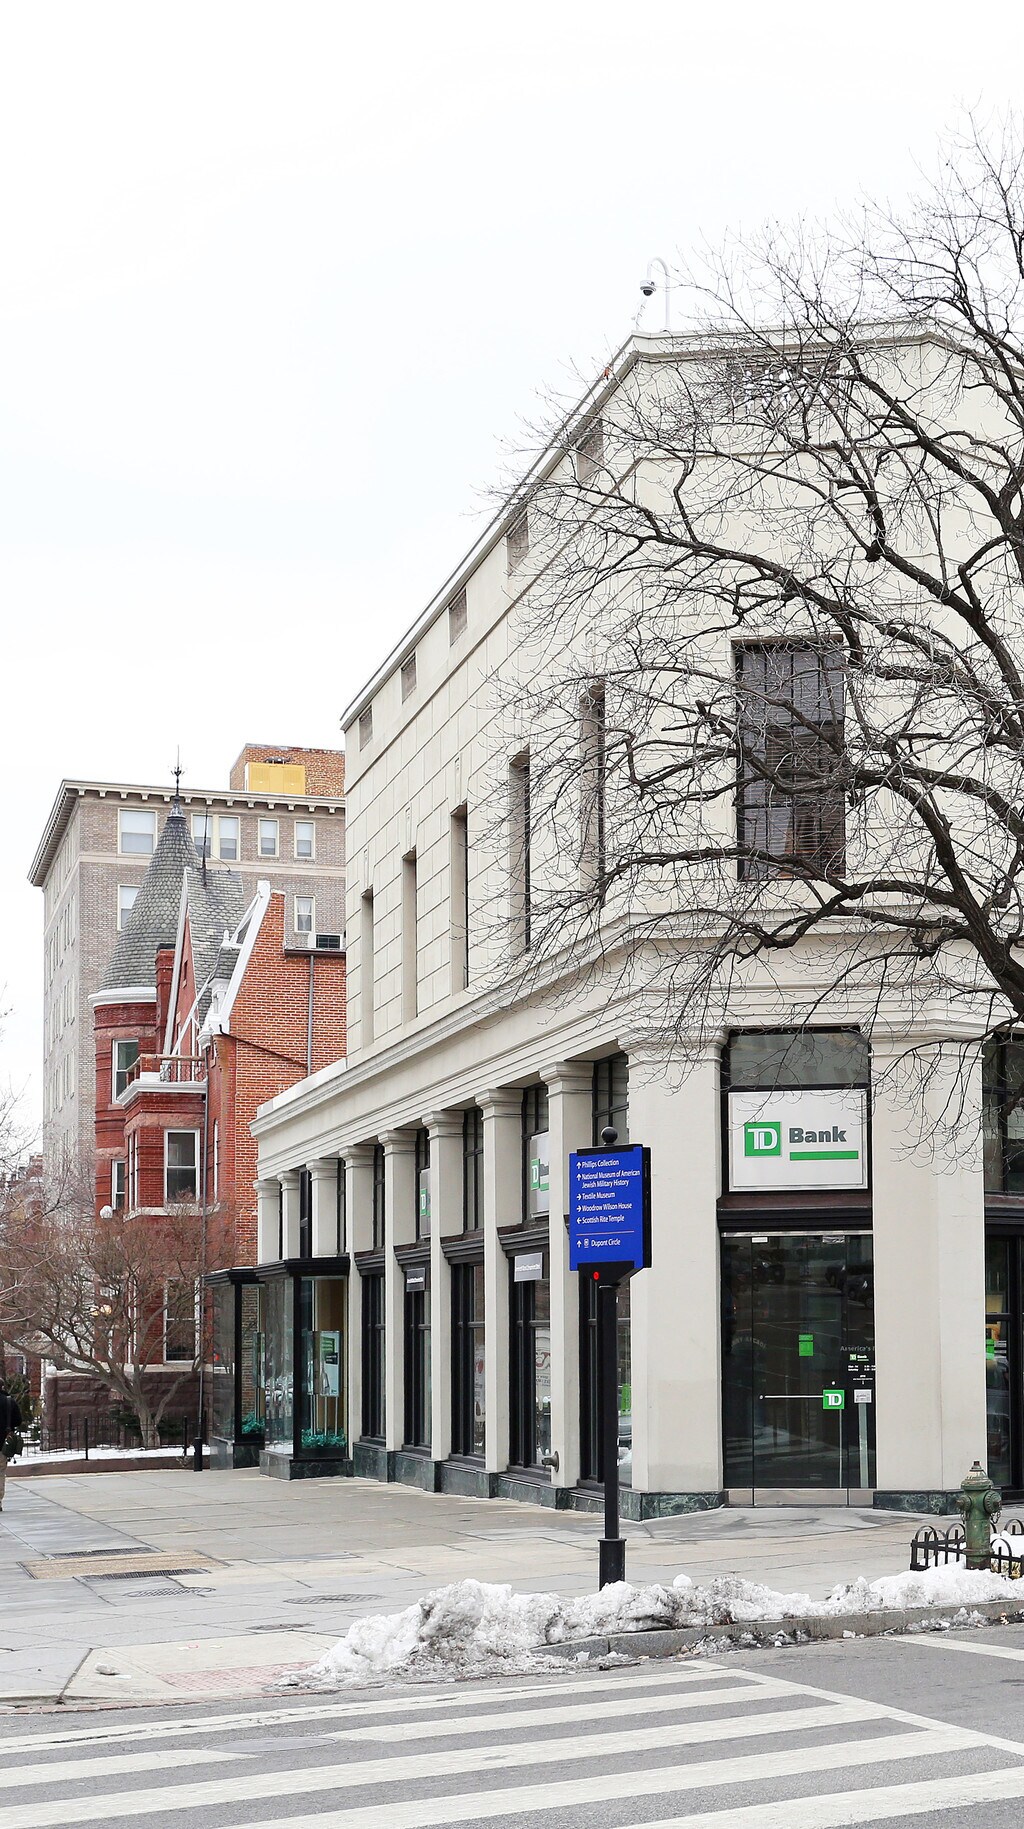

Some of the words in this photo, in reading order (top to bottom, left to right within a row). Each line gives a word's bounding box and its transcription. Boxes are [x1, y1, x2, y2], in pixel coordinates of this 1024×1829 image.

[747, 1127, 778, 1150] TD
[789, 1126, 847, 1143] Bank
[582, 1161, 597, 1169] Phillips
[597, 1159, 619, 1168] Collection
[582, 1172, 598, 1180] National
[599, 1171, 616, 1179] Museum
[616, 1169, 621, 1177] of
[621, 1169, 640, 1177] American
[582, 1181, 597, 1189] Jewish
[597, 1180, 613, 1188] Military
[613, 1179, 629, 1187] History
[582, 1192, 596, 1200] Textile
[596, 1191, 616, 1199] Museum
[582, 1204, 603, 1212] Woodrow
[582, 1215, 600, 1224] Scottish
[608, 1214, 625, 1223] Temple
[591, 1239, 608, 1247] Dupont
[608, 1238, 621, 1246] Circle
[825, 1393, 842, 1406] TD
